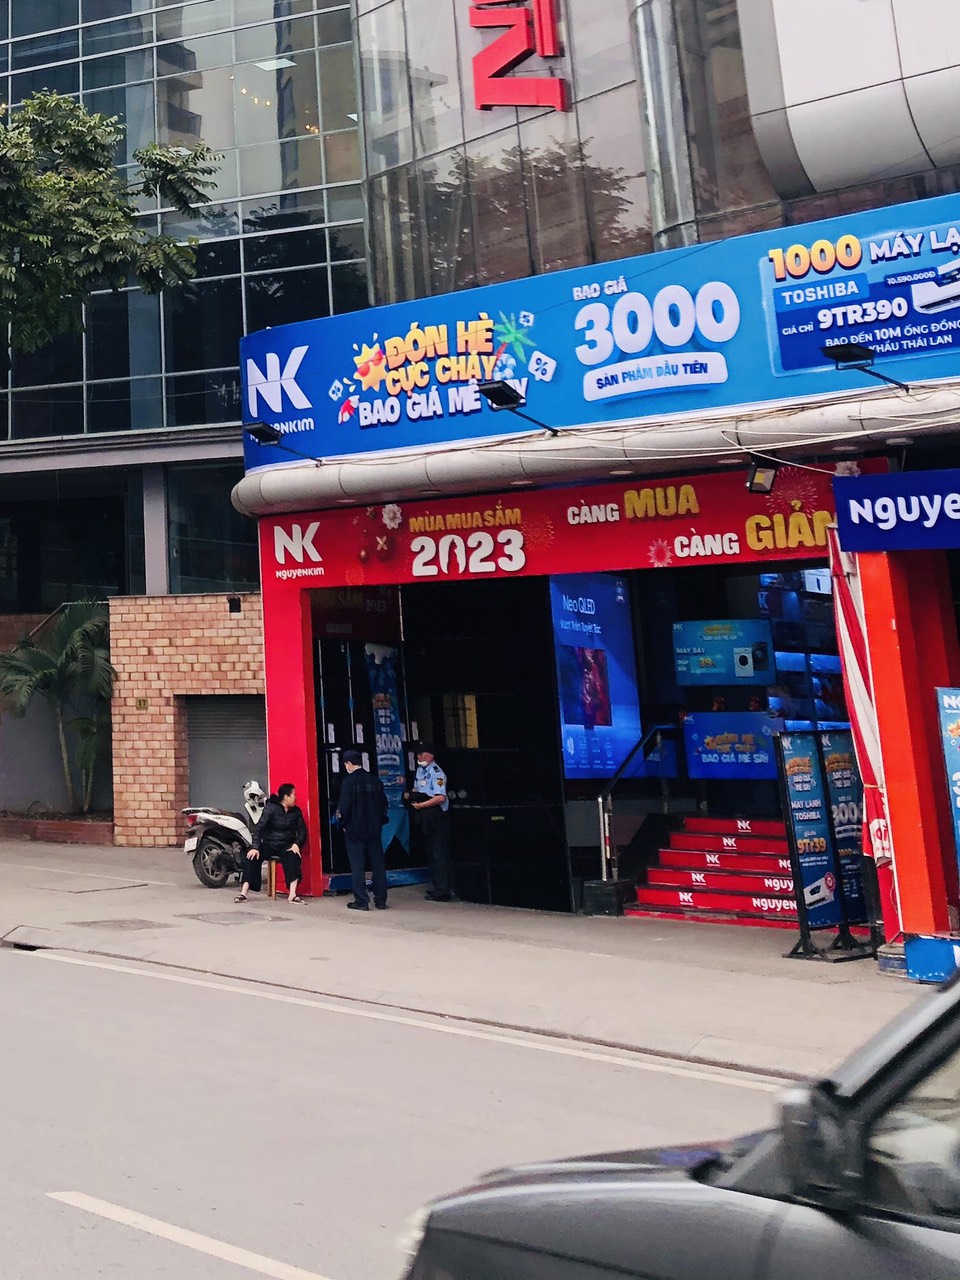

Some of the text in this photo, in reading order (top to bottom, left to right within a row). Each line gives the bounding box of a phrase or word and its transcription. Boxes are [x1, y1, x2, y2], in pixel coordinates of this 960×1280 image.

[769, 234, 862, 281] 1000
[869, 232, 925, 262] MÁY
[572, 276, 628, 300] BAO GIÁ
[781, 281, 859, 305] TOSHIBA
[574, 281, 740, 366] 3000
[782, 324, 798, 336] GIÁ
[818, 297, 908, 330] 9TR390
[384, 312, 495, 370] ĐÓN HÈ
[825, 336, 848, 347] BAO
[850, 330, 873, 344] ĐẾN
[874, 326, 902, 340] 10M
[904, 323, 929, 336] ỐNG
[901, 336, 927, 350] THÁI
[929, 334, 953, 346] LAN
[435, 349, 498, 384] CHÁY
[357, 399, 401, 427] BAO
[406, 384, 443, 419] GIÁ
[444, 511, 483, 530] MUA
[484, 500, 522, 526] SẮM
[567, 484, 700, 526] CÀNG MUA
[410, 529, 526, 577] 2023
[673, 528, 740, 558] CÀNG
